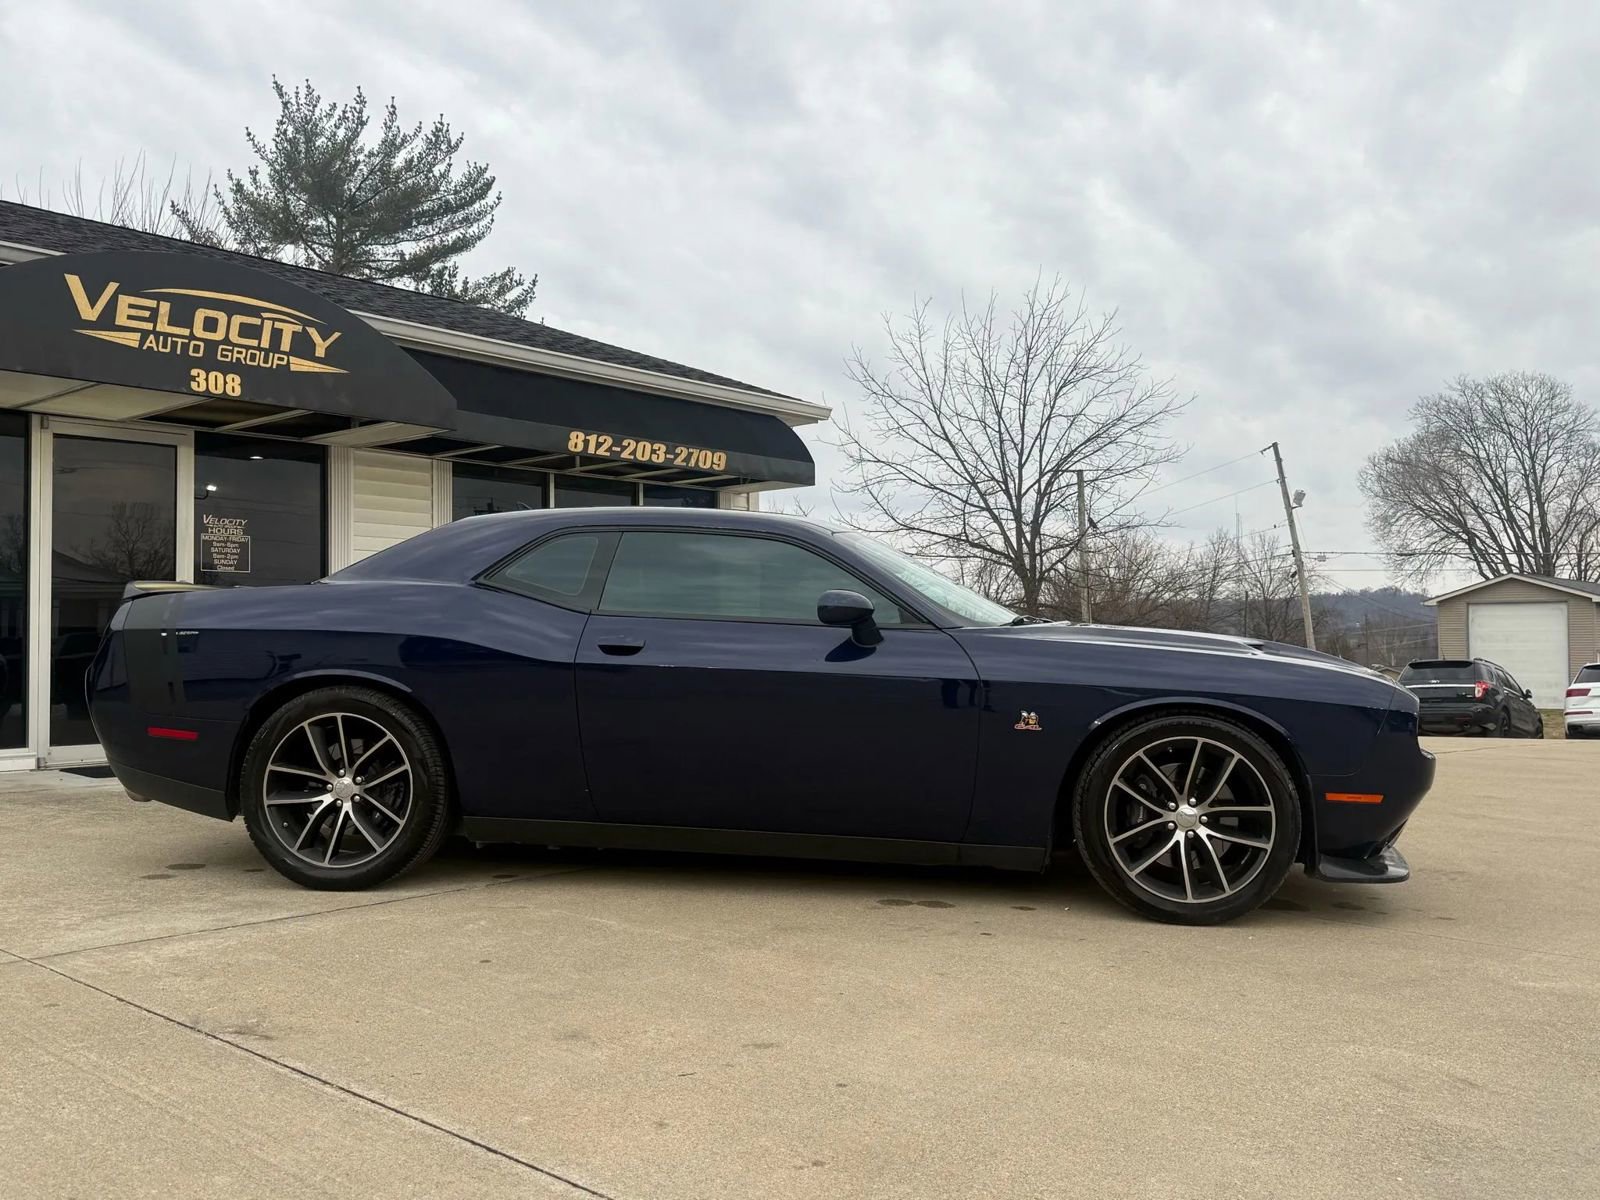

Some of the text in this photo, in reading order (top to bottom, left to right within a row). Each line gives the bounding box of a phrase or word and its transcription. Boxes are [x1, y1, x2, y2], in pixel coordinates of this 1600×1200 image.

[64, 273, 342, 358] VELOCITY
[142, 333, 288, 369] AUTO GROUP
[190, 368, 241, 397] 308
[567, 431, 727, 471] 812-203-2709
[203, 514, 248, 526] VELOCITY
[208, 527, 243, 535] HOURS
